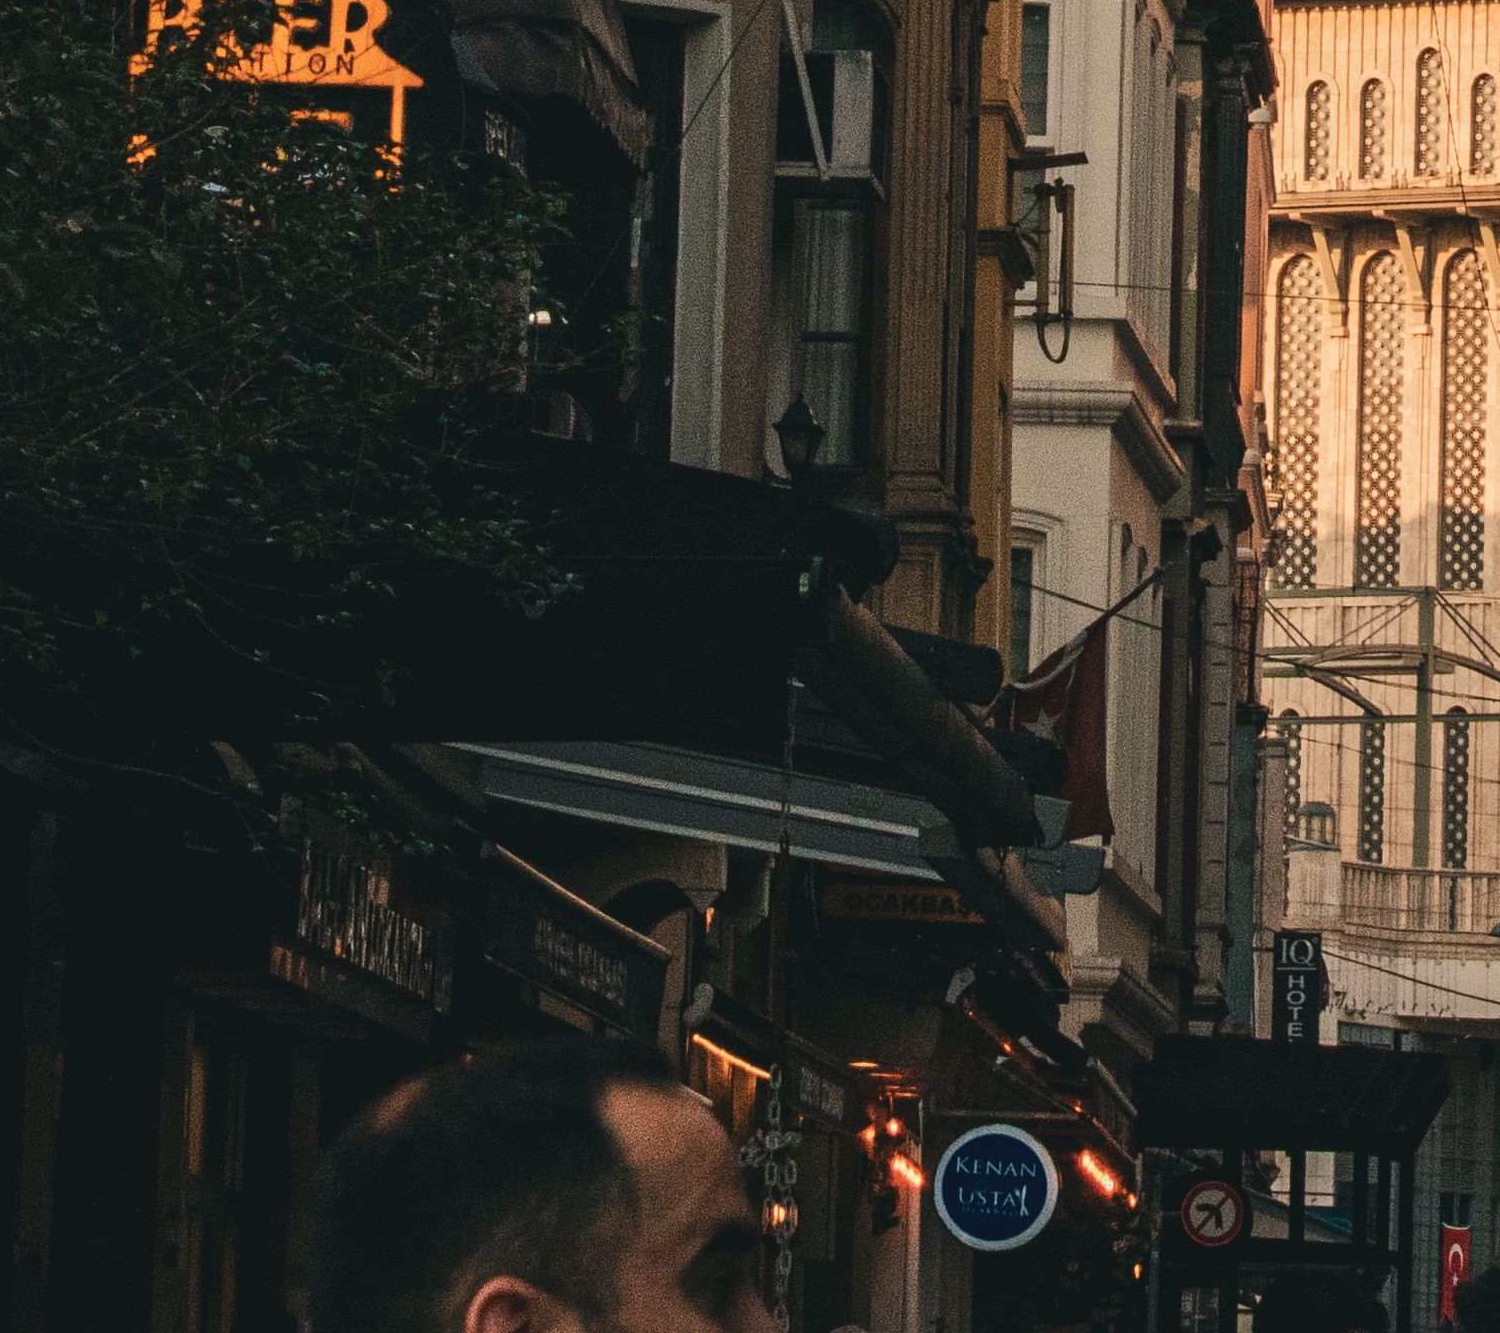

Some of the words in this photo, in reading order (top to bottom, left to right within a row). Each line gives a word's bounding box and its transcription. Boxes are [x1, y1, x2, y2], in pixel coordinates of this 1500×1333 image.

[1281, 937, 1315, 967] IQ
[1285, 974, 1307, 1043] HOTE
[955, 1155, 1037, 1179] KENAN
